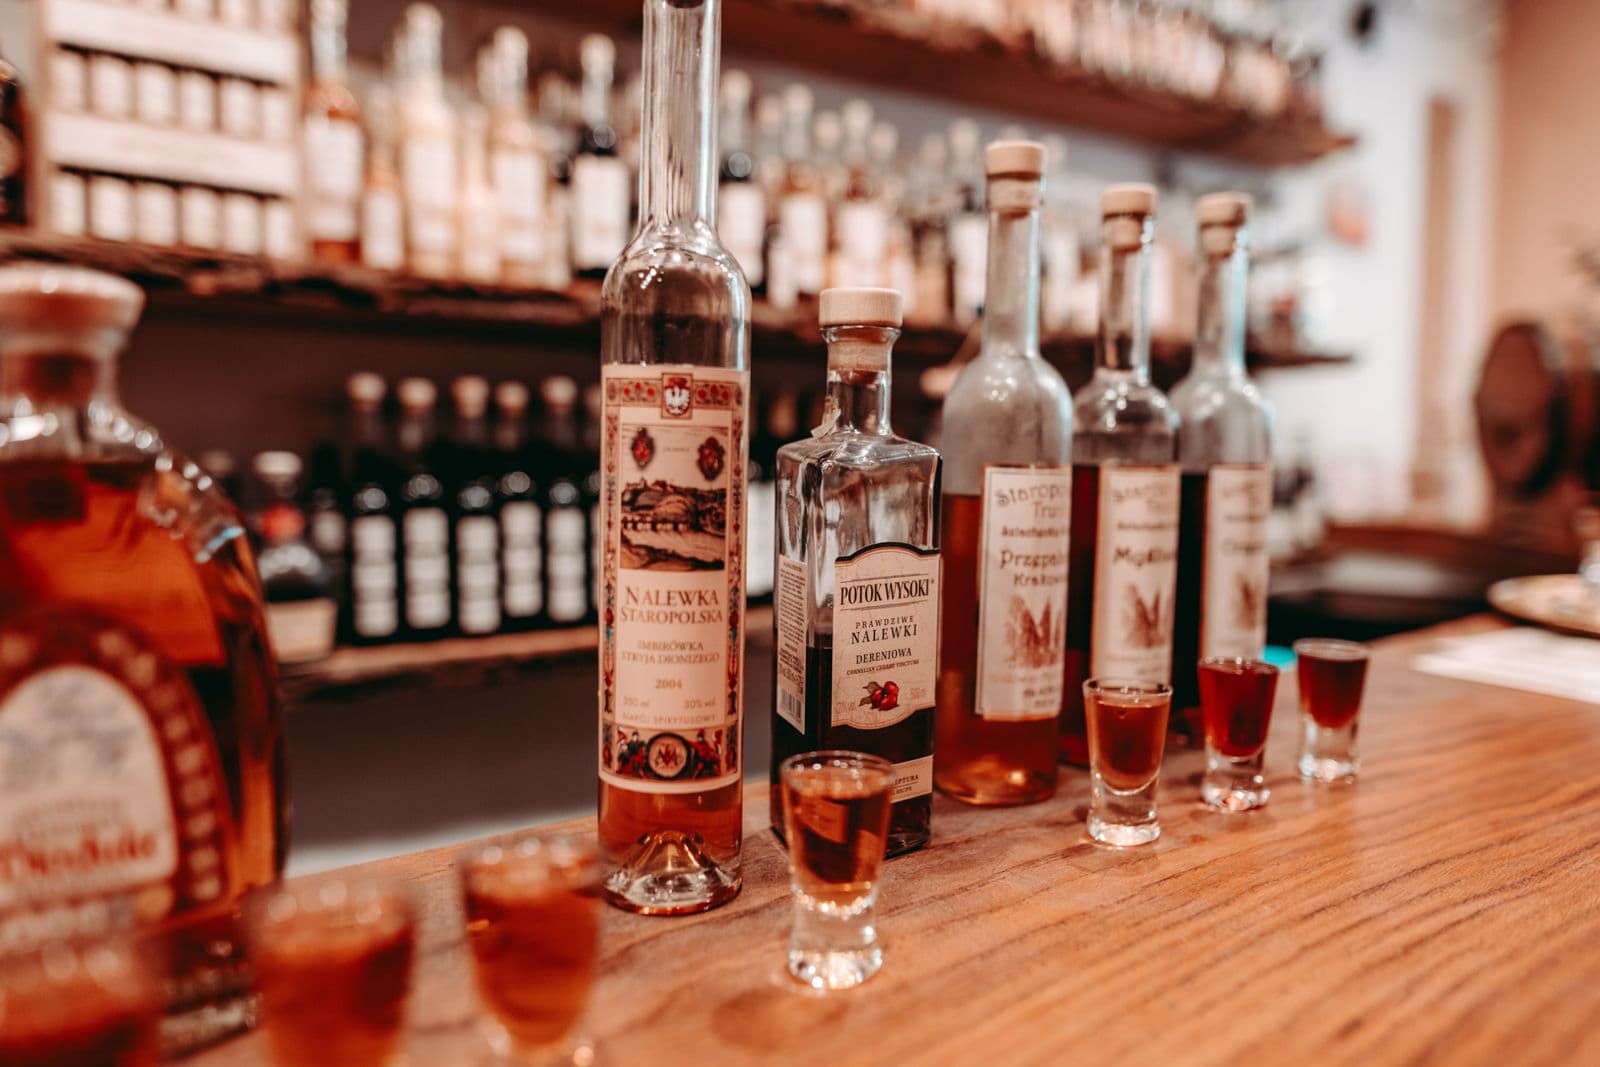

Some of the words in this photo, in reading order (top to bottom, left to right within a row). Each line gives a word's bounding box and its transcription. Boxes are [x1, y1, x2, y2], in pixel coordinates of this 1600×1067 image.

[625, 586, 719, 606] NALEWKA
[840, 583, 882, 606] POTOK
[884, 579, 929, 601] WYSOKI
[620, 607, 722, 624] STAROPOLSKA
[856, 616, 914, 629] PRAWDZIWE
[851, 624, 917, 645] NALEWKI
[856, 648, 912, 665] DERENIOWA
